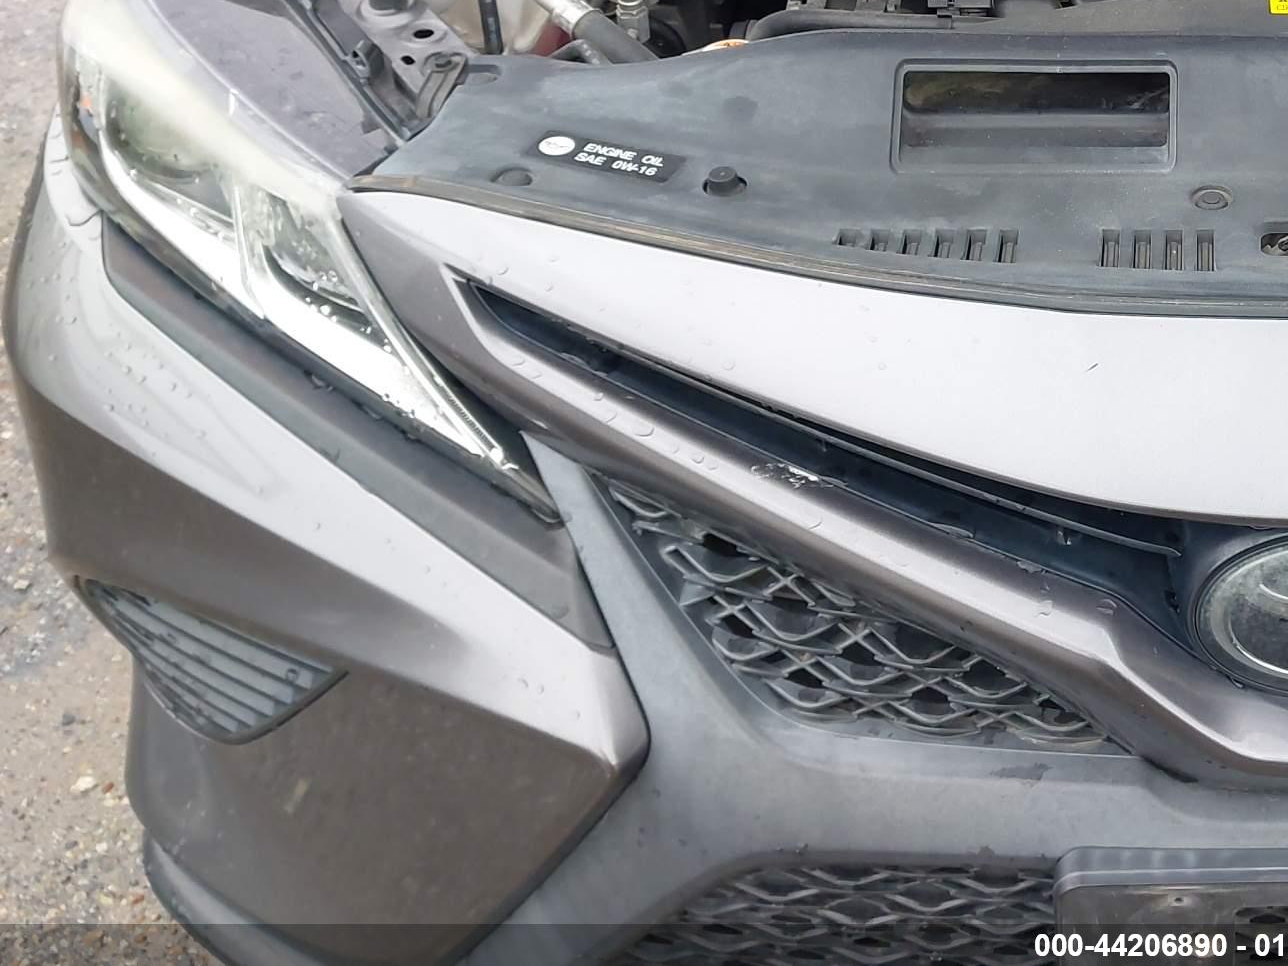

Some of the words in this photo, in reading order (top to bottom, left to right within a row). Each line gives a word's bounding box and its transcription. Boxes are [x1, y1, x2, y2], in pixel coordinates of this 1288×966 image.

[573, 152, 607, 166] SAE
[611, 160, 658, 176] 0W-16
[583, 142, 638, 161] ENGINE
[641, 154, 664, 167] OIL
